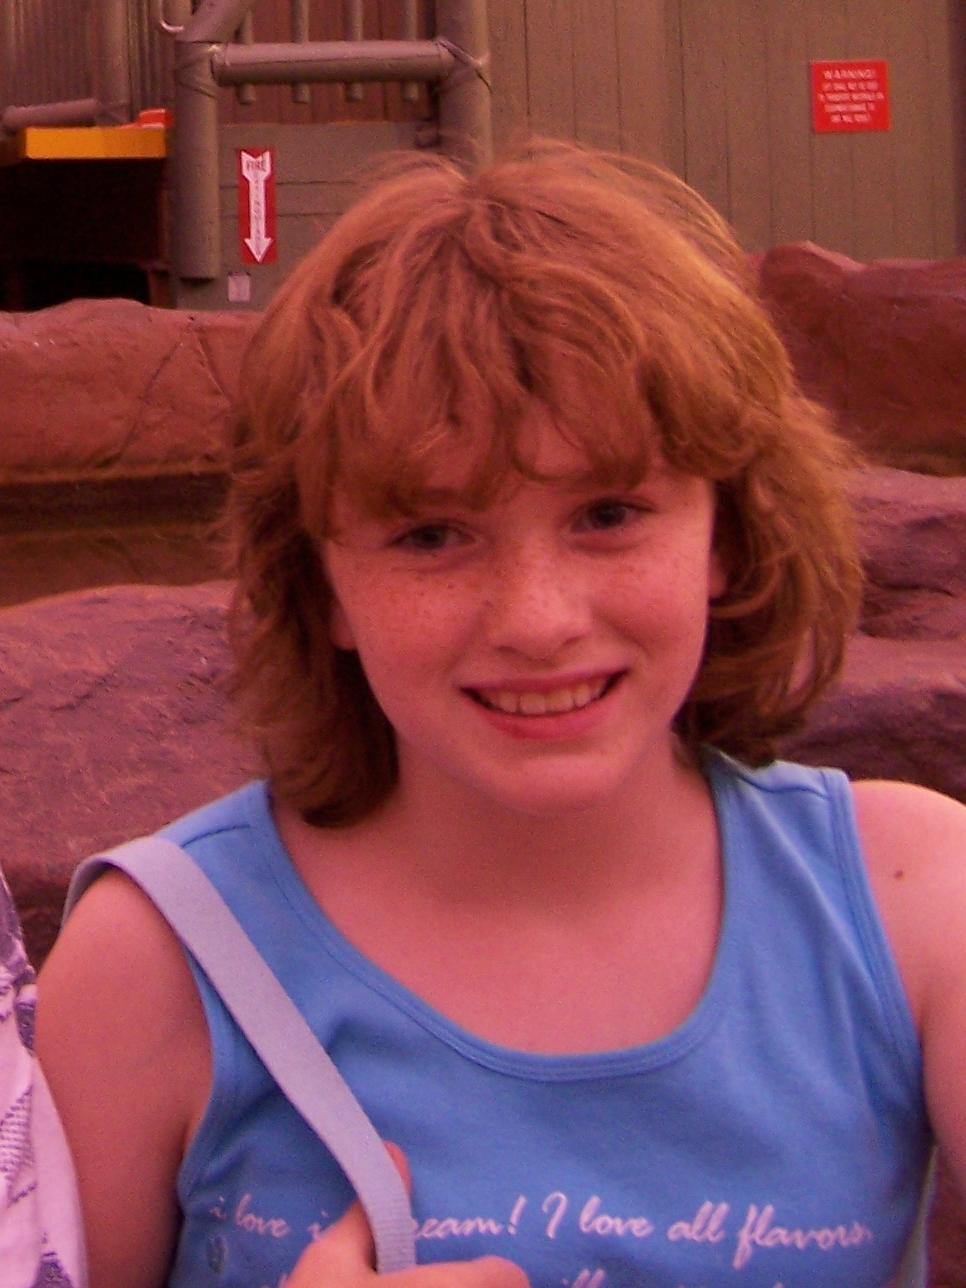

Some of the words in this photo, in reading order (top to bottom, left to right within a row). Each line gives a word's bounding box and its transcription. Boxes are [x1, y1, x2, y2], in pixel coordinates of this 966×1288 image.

[236, 1193, 290, 1238] love
[410, 1195, 527, 1239] eam!
[541, 1191, 568, 1239] I
[579, 1195, 653, 1238] love
[666, 1200, 729, 1244] all
[732, 1203, 873, 1269] flavors
